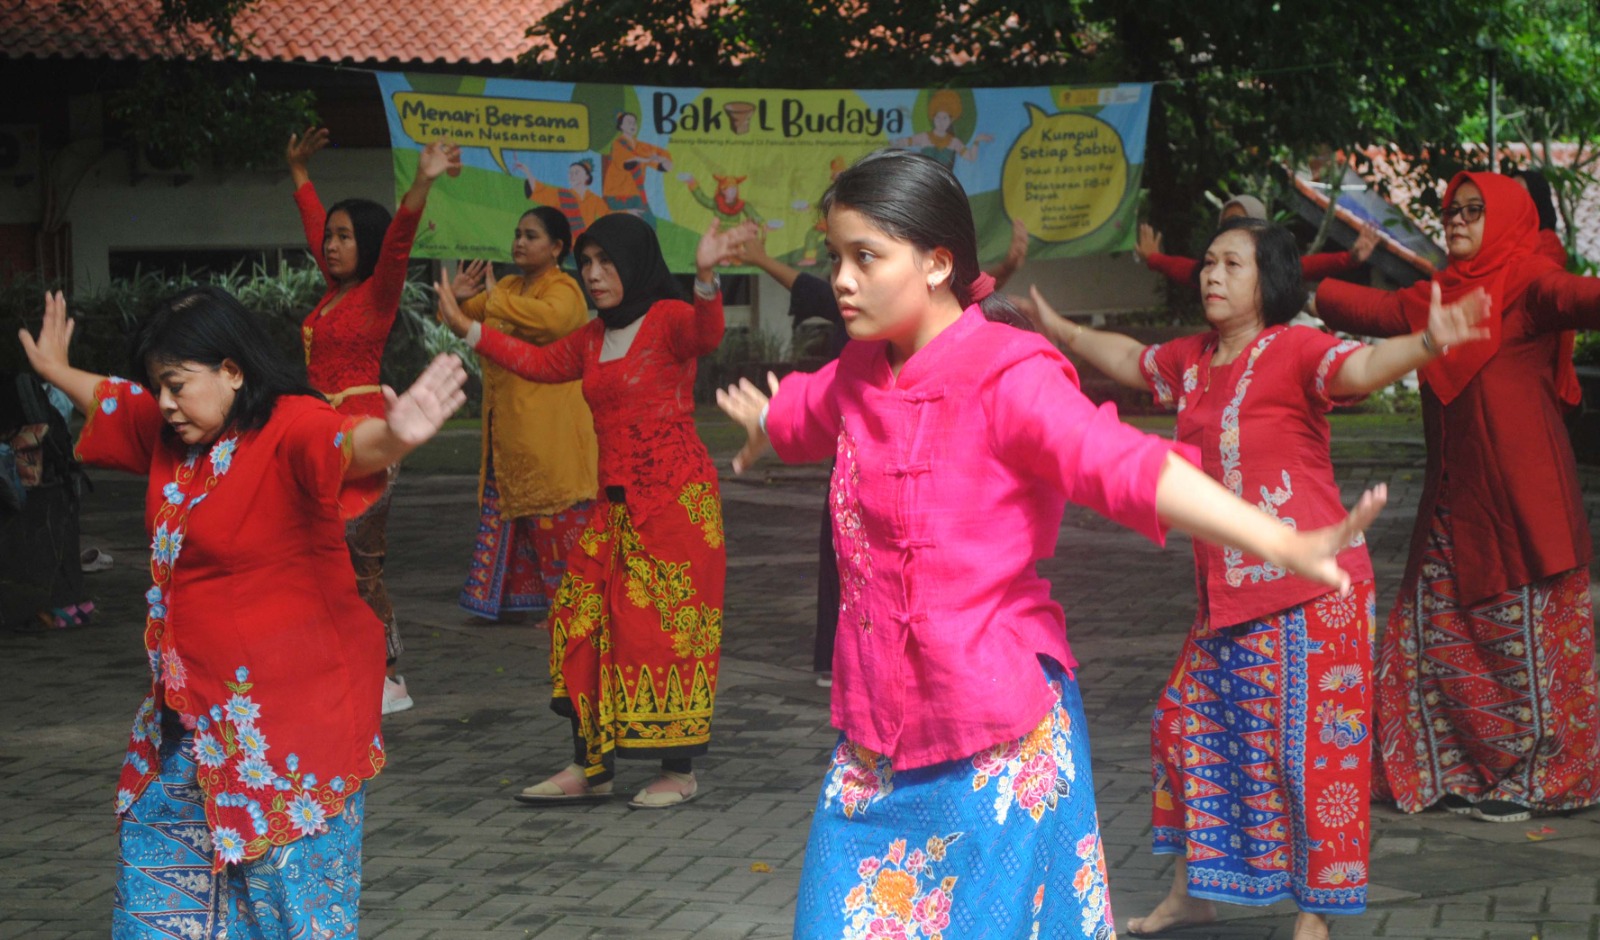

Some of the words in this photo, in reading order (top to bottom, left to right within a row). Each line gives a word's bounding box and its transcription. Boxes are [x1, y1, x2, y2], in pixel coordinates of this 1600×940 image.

[402, 100, 480, 124] Menari
[485, 105, 579, 130] Bersama
[781, 98, 904, 138] Budaya
[418, 123, 474, 139] Tarian
[479, 127, 566, 144] Nusantara
[1041, 127, 1099, 146] Kumpul
[1020, 146, 1068, 162] Setiap
[1074, 142, 1117, 157] Sabtu
